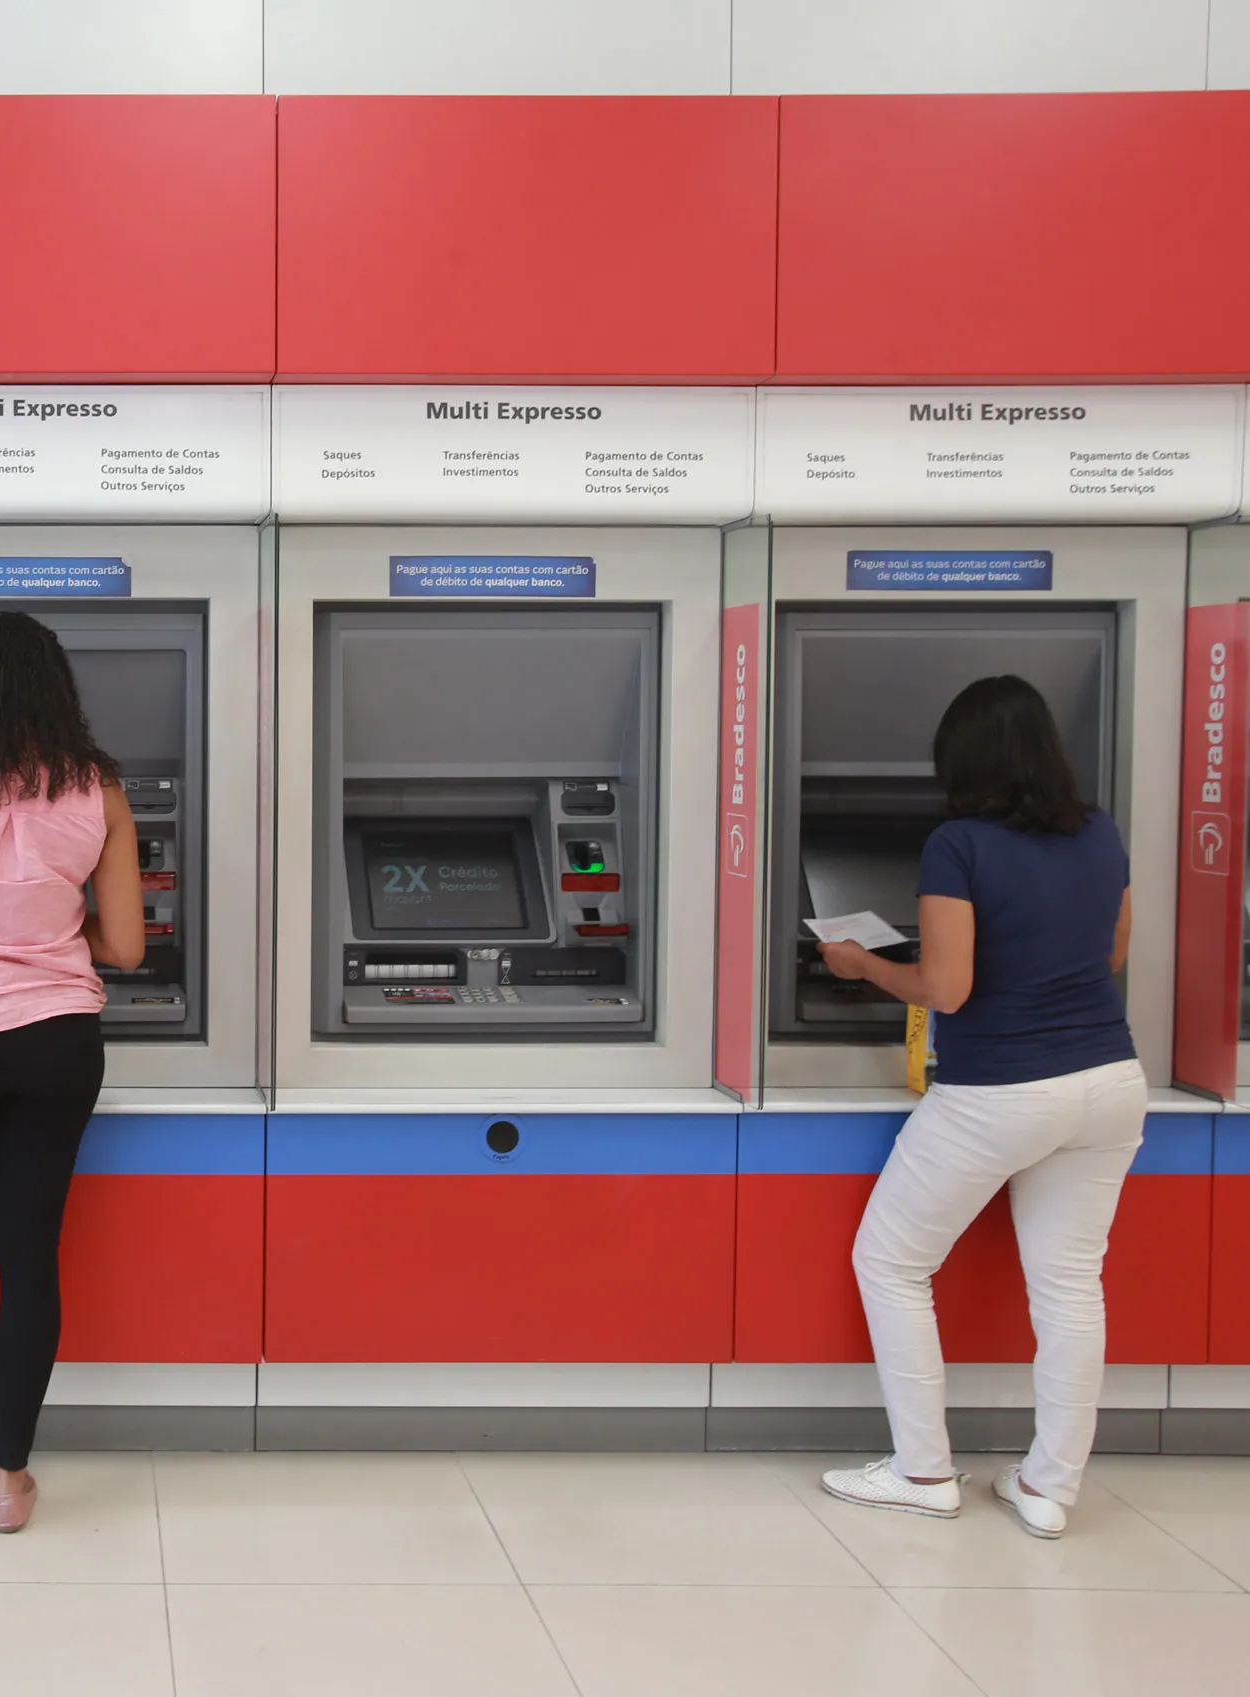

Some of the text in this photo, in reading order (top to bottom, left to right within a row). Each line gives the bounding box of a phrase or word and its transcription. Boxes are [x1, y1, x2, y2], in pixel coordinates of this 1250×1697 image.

[13, 399, 117, 422] Expresso
[426, 400, 602, 425] Multi Expresso
[909, 402, 1086, 426] Multi Expresso
[101, 448, 220, 461] Pagamento de Contas
[323, 450, 362, 462] Saques
[442, 449, 520, 461] Transferências
[585, 450, 703, 464] Pagamento de Contas
[806, 452, 845, 465] Saques
[925, 451, 1004, 463] Transferências
[1069, 450, 1190, 464] Pagamento de Contas
[101, 464, 204, 476] Consulta de Saldos
[321, 467, 375, 481] Depósitos
[442, 466, 519, 477] Investimentos
[585, 466, 687, 478] Consulta de Saldos
[806, 468, 855, 481] Depósito
[926, 467, 1003, 479] Investimentos
[1070, 466, 1173, 478] Consulta de Saldos
[100, 480, 185, 494] Outros Serviços
[585, 483, 669, 496] Outros Serviços
[1069, 483, 1155, 497] Outros Serviços
[6, 566, 30, 575] suas
[32, 565, 67, 575] contas
[68, 567, 90, 575] com
[91, 564, 126, 575] cartão
[396, 563, 589, 576] Pague aqui as suas contas com cartão
[853, 558, 1047, 571] Pague aqui as suas contas com cartão
[7, 576, 19, 585] de
[21, 577, 65, 589] qualquer
[67, 577, 101, 588] banco.
[420, 576, 565, 589] de débito de qualquer banco.
[877, 570, 1022, 583] de débito de qualquer banco.
[731, 643, 746, 805] Bradesco
[1201, 641, 1227, 804] Bradesco
[381, 863, 431, 893] 2X
[438, 864, 498, 879] Crédito
